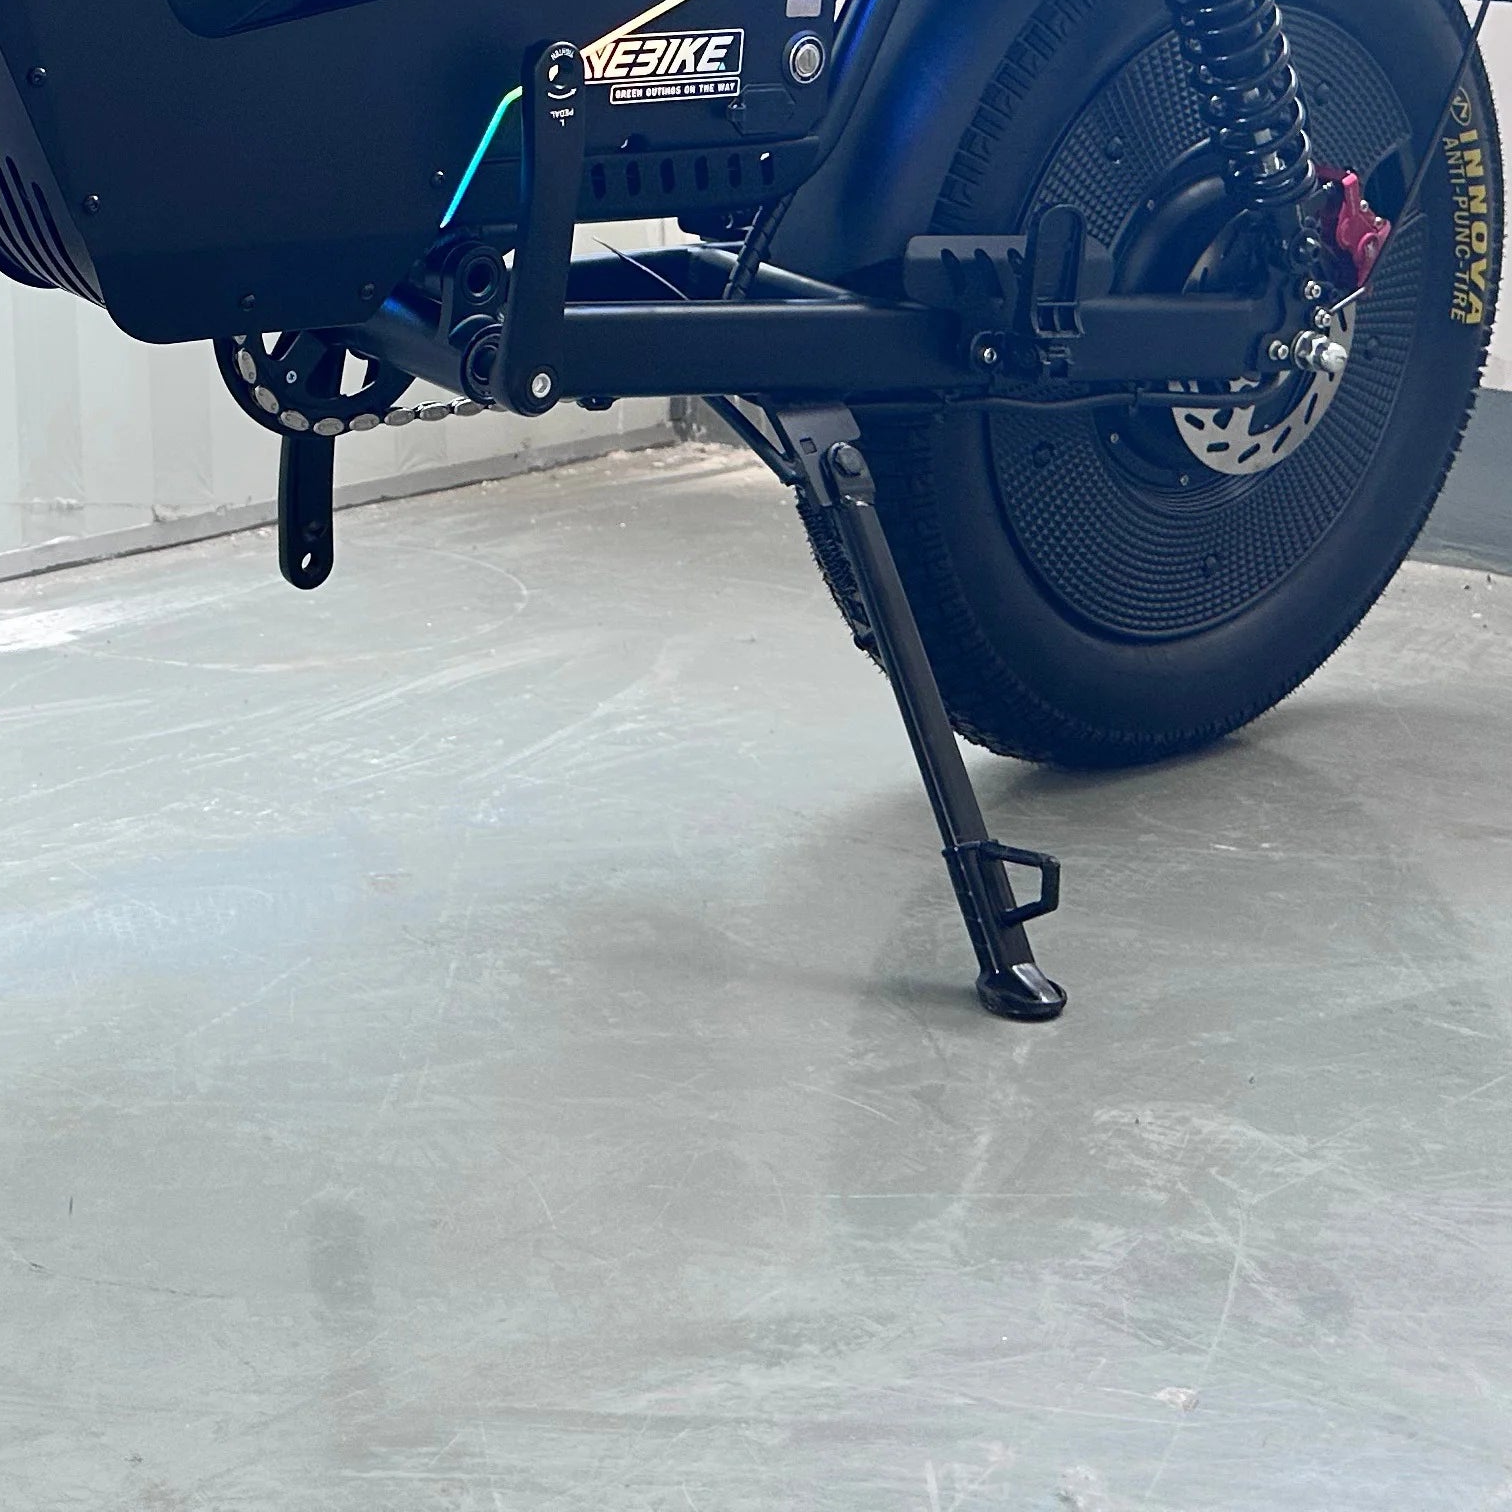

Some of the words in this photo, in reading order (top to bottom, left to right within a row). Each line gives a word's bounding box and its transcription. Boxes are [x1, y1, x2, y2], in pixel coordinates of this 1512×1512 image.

[583, 35, 734, 80] YEBIKE
[699, 83, 715, 93] THE
[718, 82, 735, 92] WAY
[549, 108, 574, 119] PEDAL
[1442, 137, 1472, 325] ANTI-PUNC-TIRE
[1458, 128, 1488, 325] INNOVA
